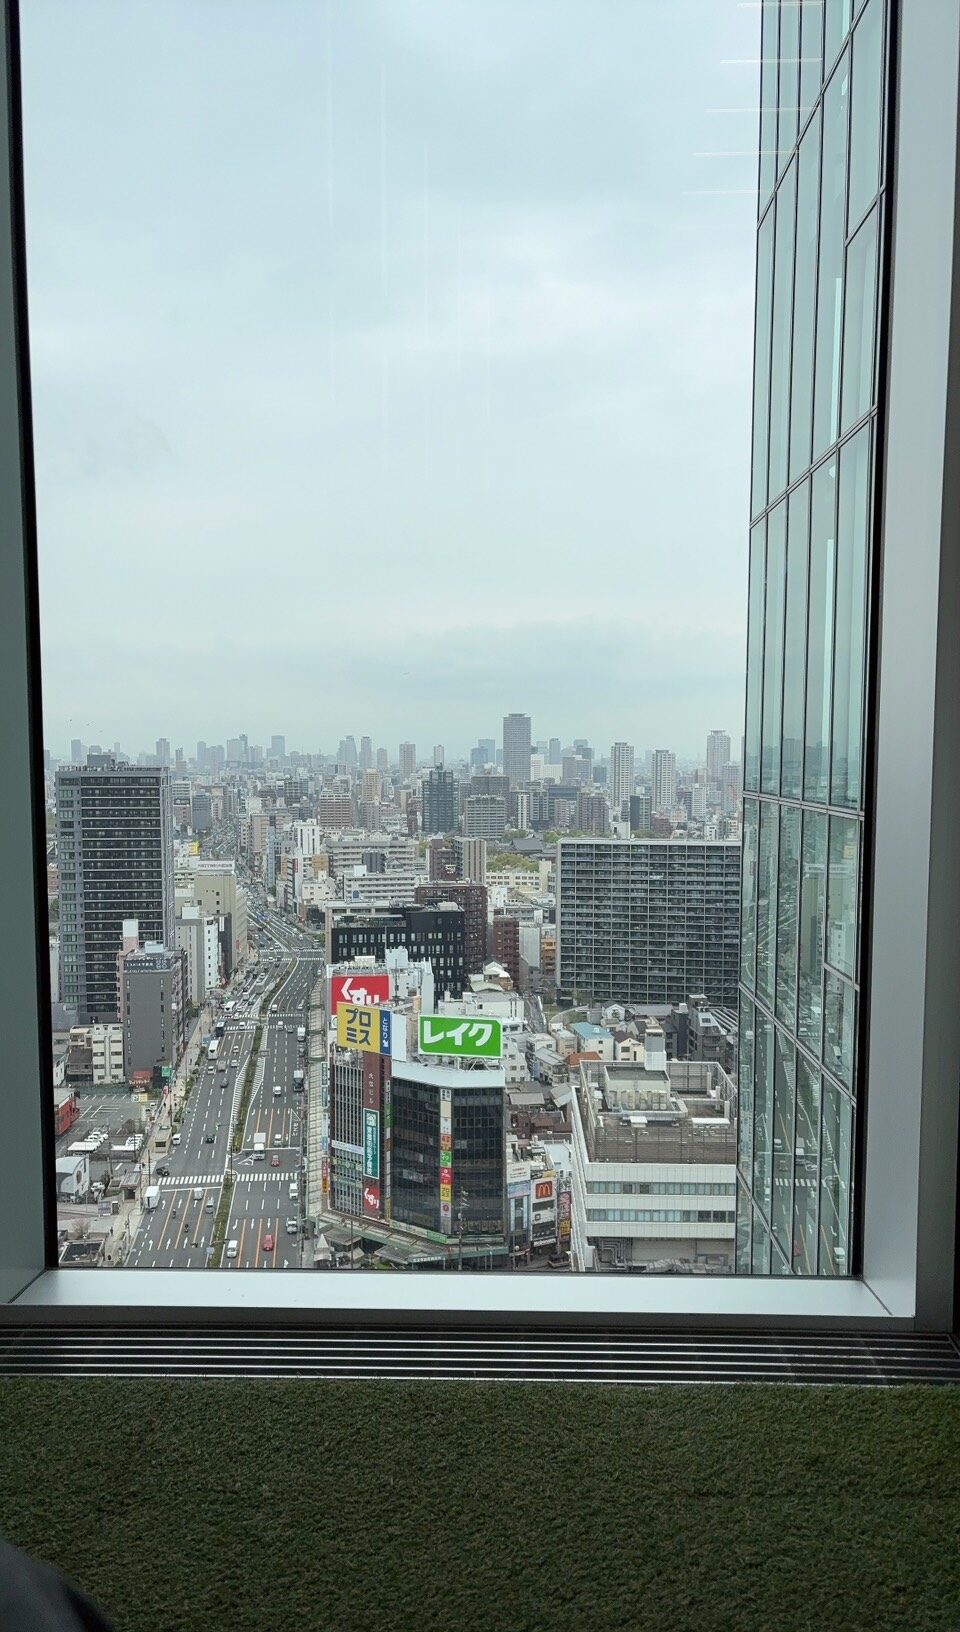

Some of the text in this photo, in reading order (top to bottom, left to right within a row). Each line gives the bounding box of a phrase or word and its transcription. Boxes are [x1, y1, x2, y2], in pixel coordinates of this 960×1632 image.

[346, 1008, 371, 1027] プロ
[346, 1027, 371, 1046] ミス
[424, 1021, 492, 1047] レイク
[364, 1187, 380, 1209] くすり
